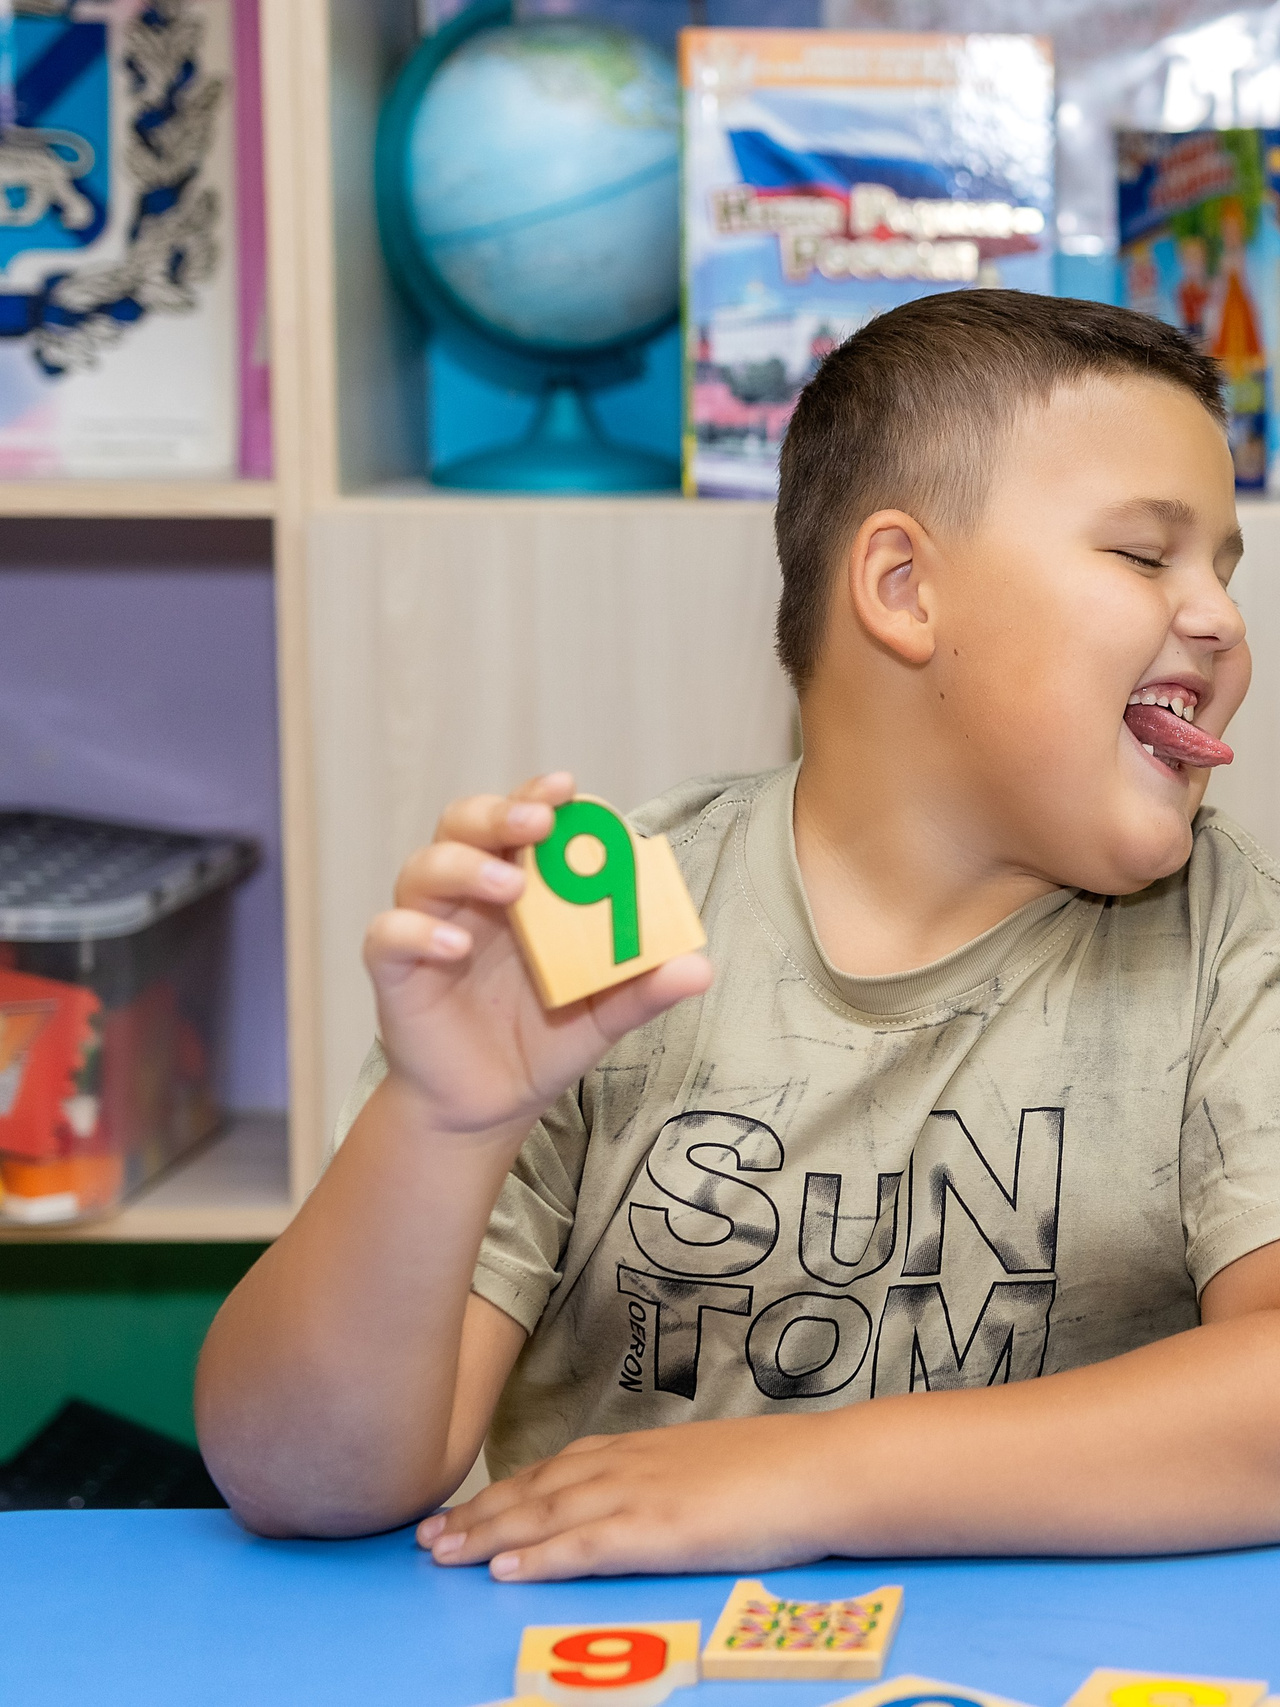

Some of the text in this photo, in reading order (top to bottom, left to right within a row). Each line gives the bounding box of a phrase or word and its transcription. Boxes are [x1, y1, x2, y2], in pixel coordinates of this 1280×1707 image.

[534, 801, 640, 965] 9
[617, 1264, 1057, 1400] TOM
[618, 1300, 648, 1394] OERON
[549, 1630, 668, 1688] 9
